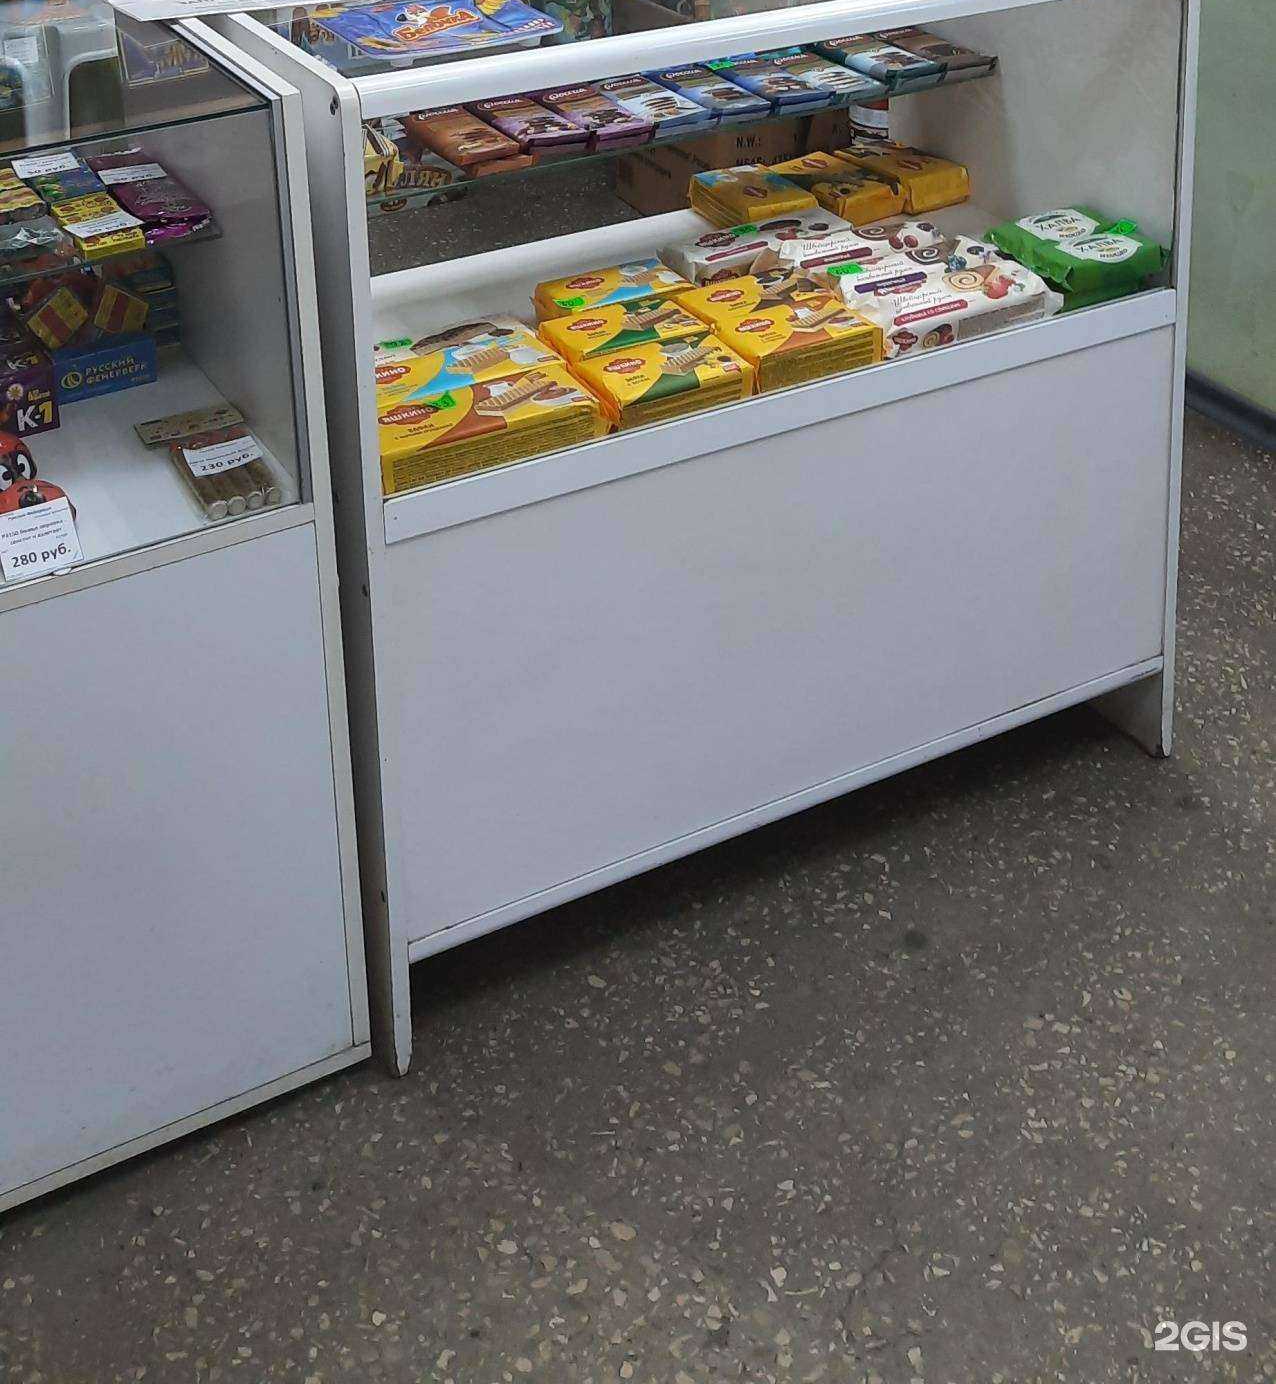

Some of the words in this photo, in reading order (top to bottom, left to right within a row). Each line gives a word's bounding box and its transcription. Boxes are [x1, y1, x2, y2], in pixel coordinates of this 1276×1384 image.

[85, 355, 136, 376] РУССКИЙ
[86, 364, 147, 384] ФЕЙЕРВЕРК
[381, 406, 435, 423] ЯШКИНО
[200, 461, 224, 472] 230
[226, 453, 255, 466] руб.
[11, 552, 38, 568] 280
[41, 542, 72, 563] руб.
